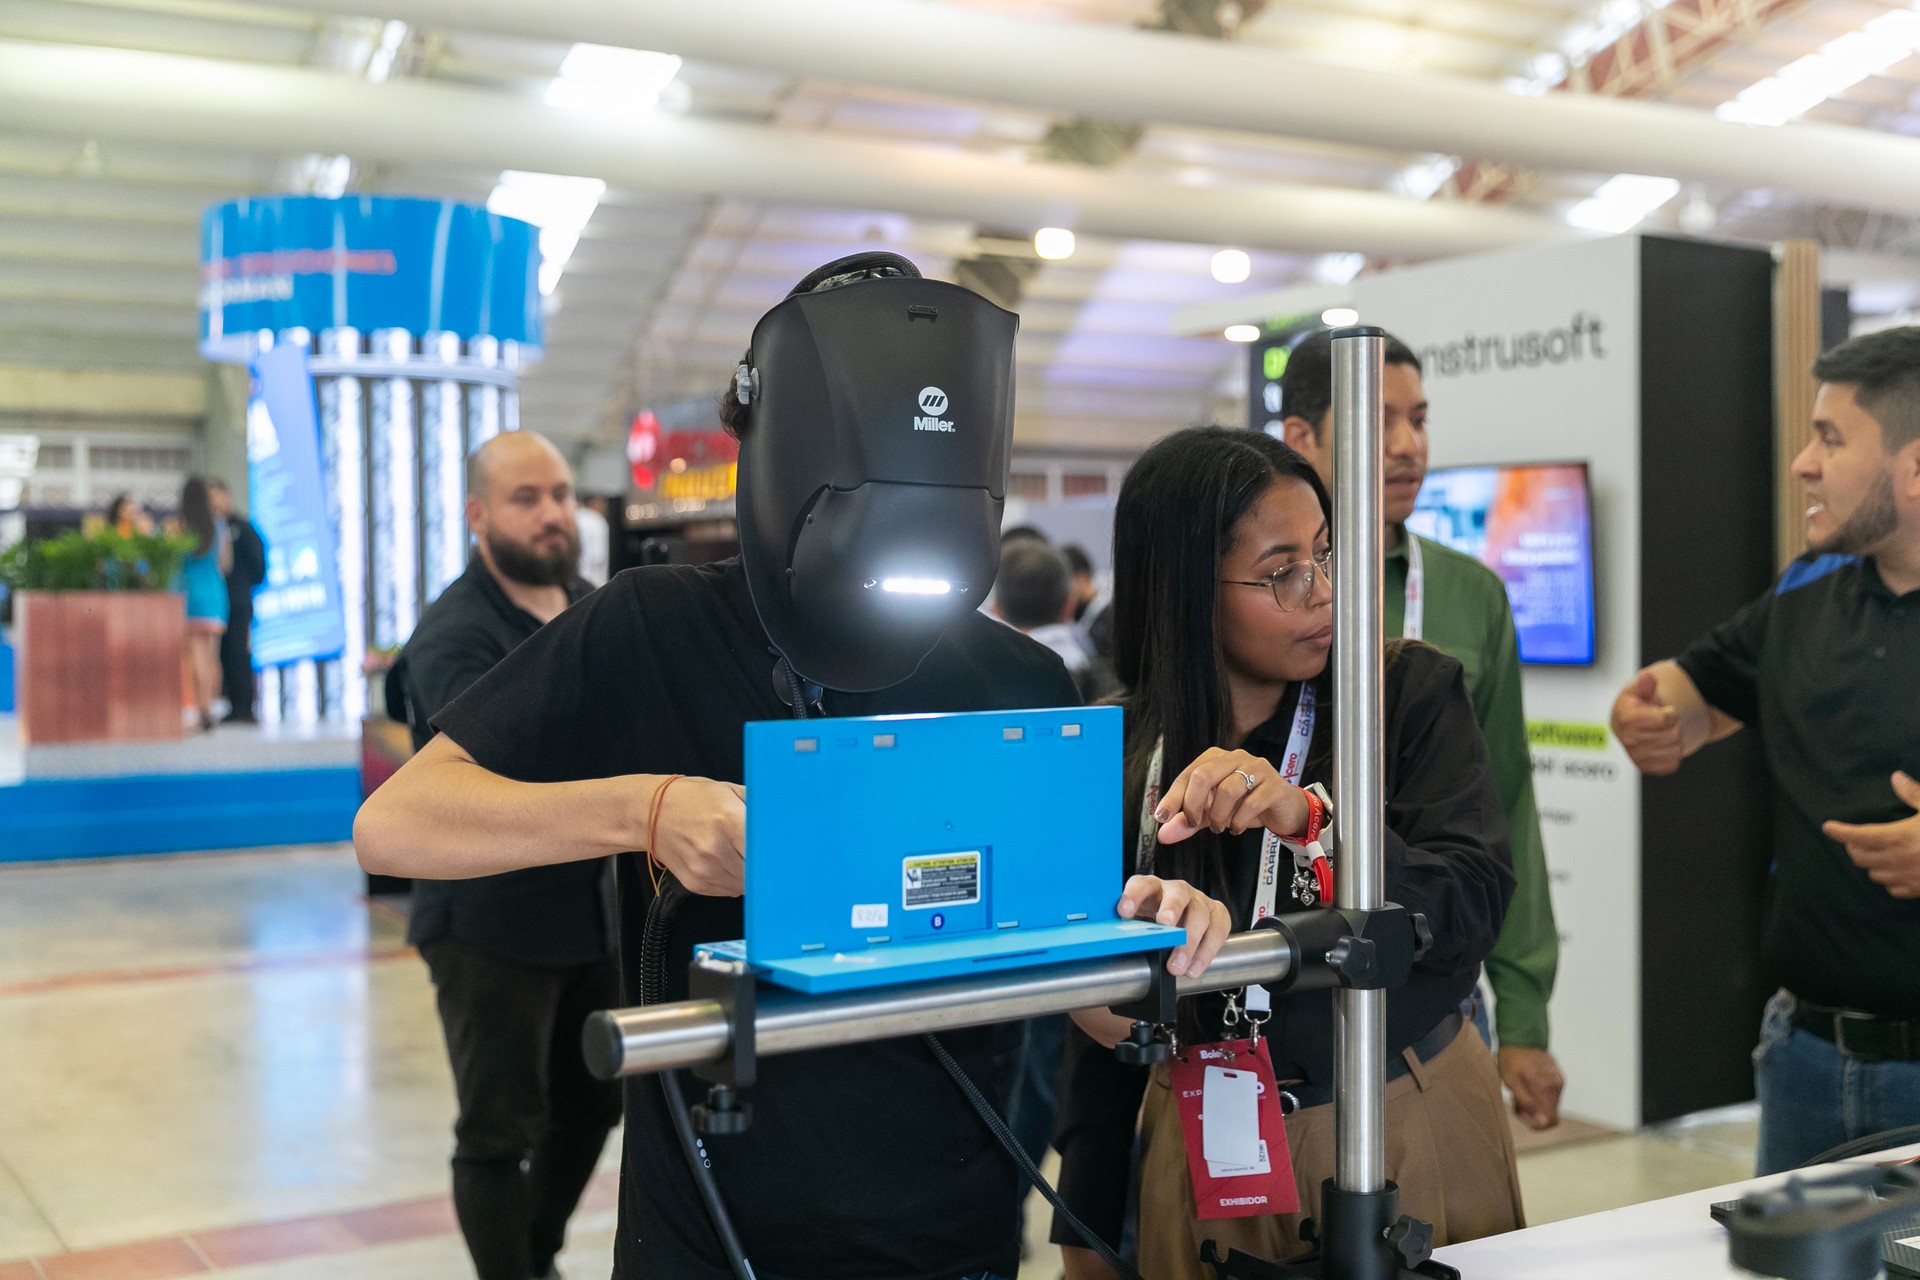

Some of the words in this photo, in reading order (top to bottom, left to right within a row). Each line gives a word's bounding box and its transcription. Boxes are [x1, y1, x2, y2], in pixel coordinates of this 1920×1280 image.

[1419, 310, 1608, 377] nstrusoft
[1266, 835, 1279, 886] CARRU
[1182, 1089, 1203, 1098] EXP
[1220, 1195, 1268, 1207] EXHIBIDOR
